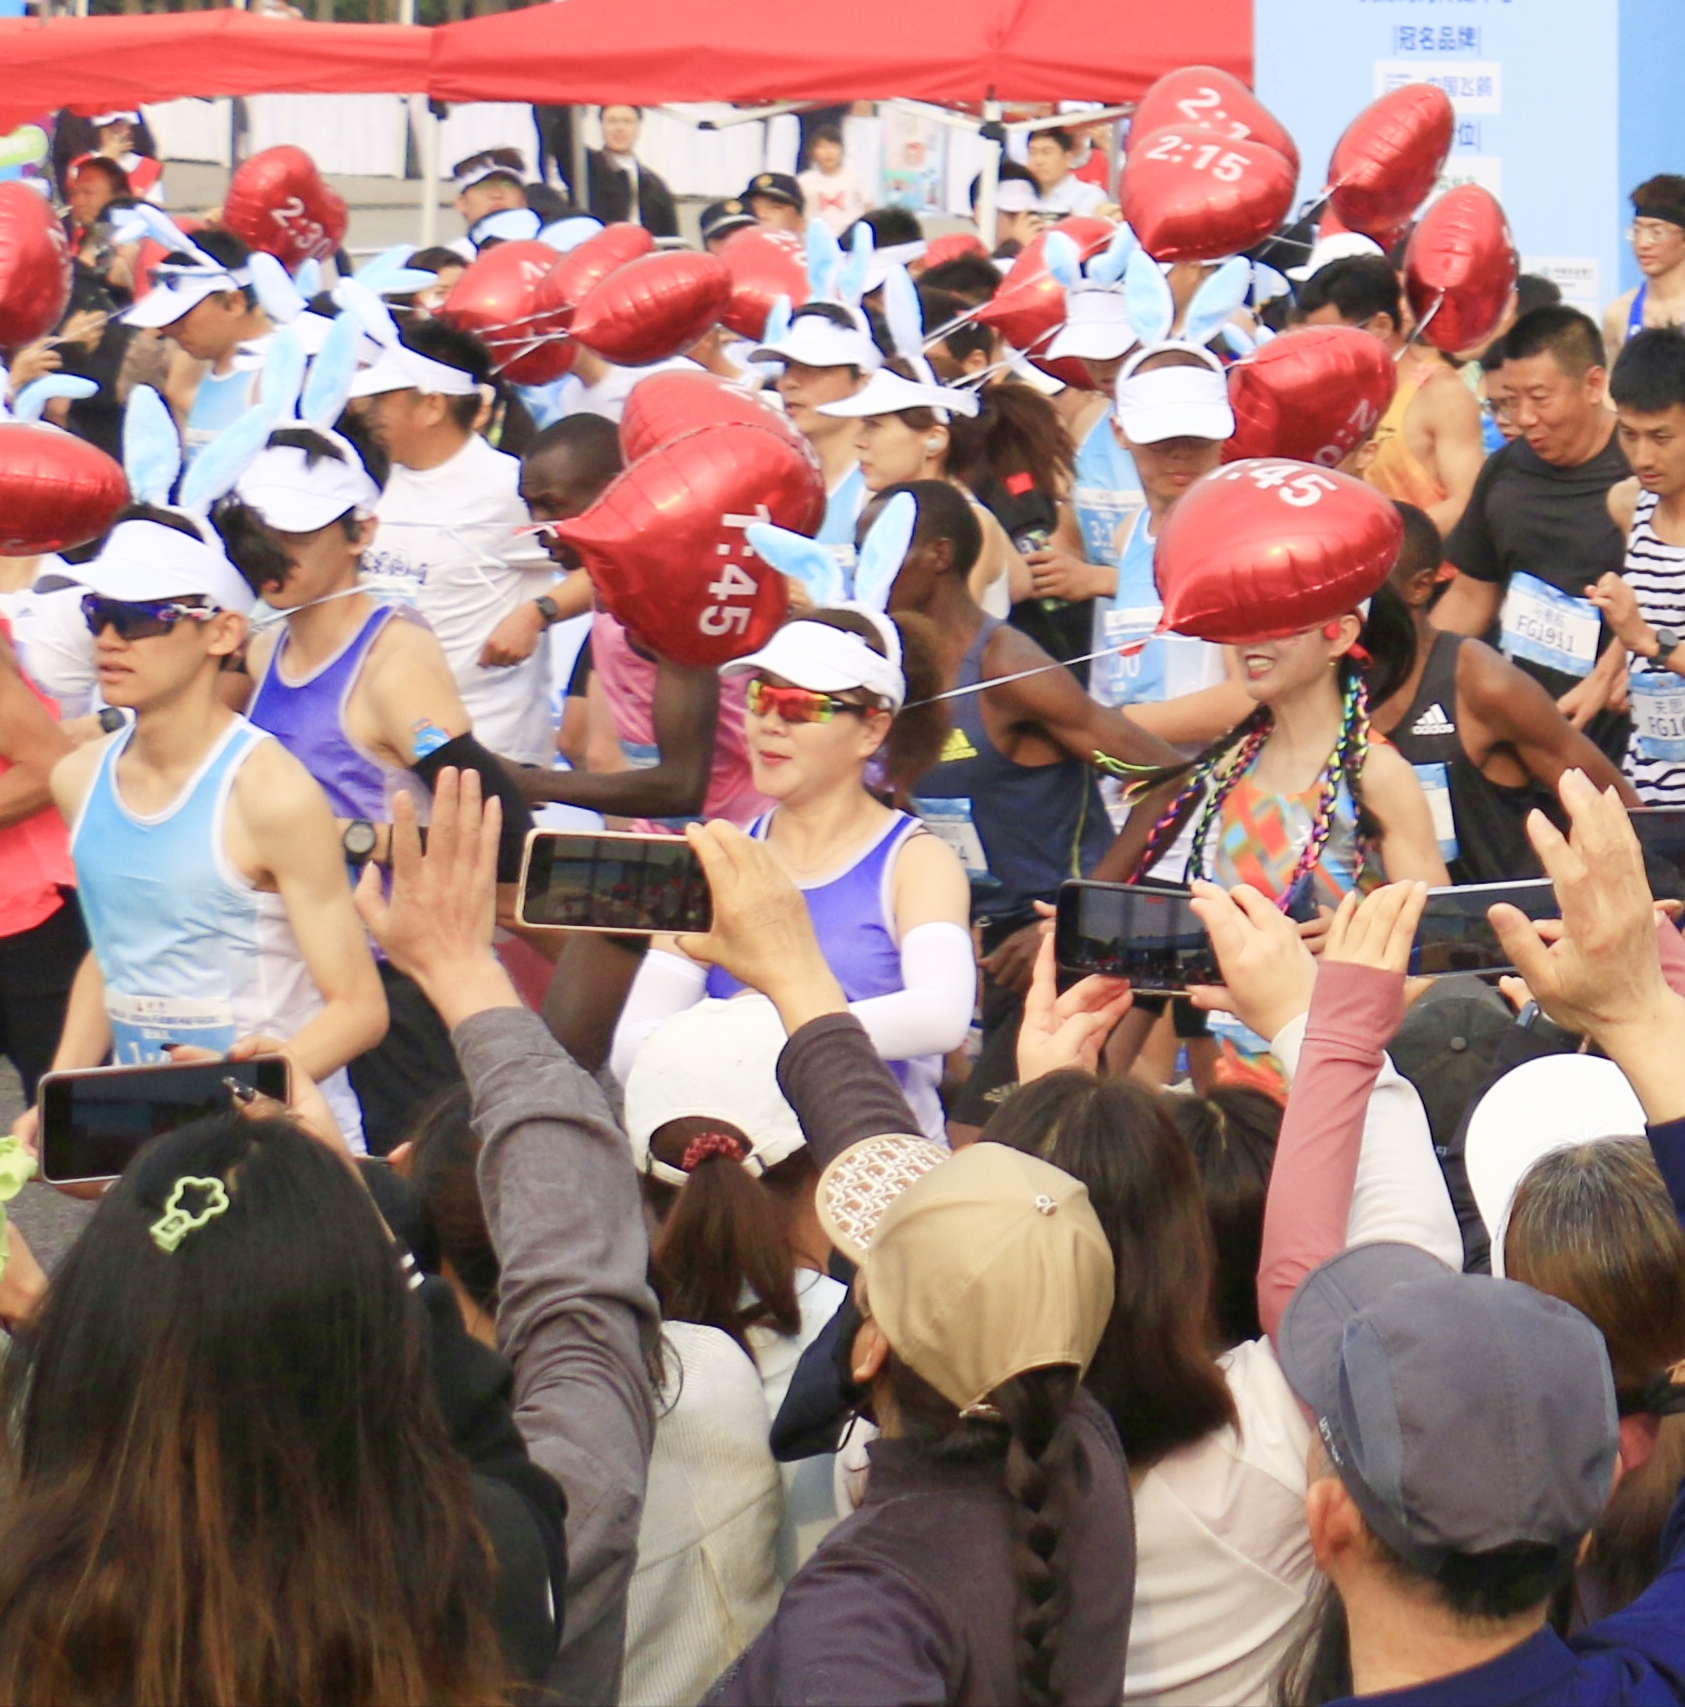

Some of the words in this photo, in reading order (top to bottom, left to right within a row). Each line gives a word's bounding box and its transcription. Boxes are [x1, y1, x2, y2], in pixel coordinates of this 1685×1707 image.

[1145, 135, 1252, 182] 2:15
[699, 503, 772, 637] 1:45
[1516, 613, 1575, 654] FG1911
[1411, 723, 1456, 735] adidas
